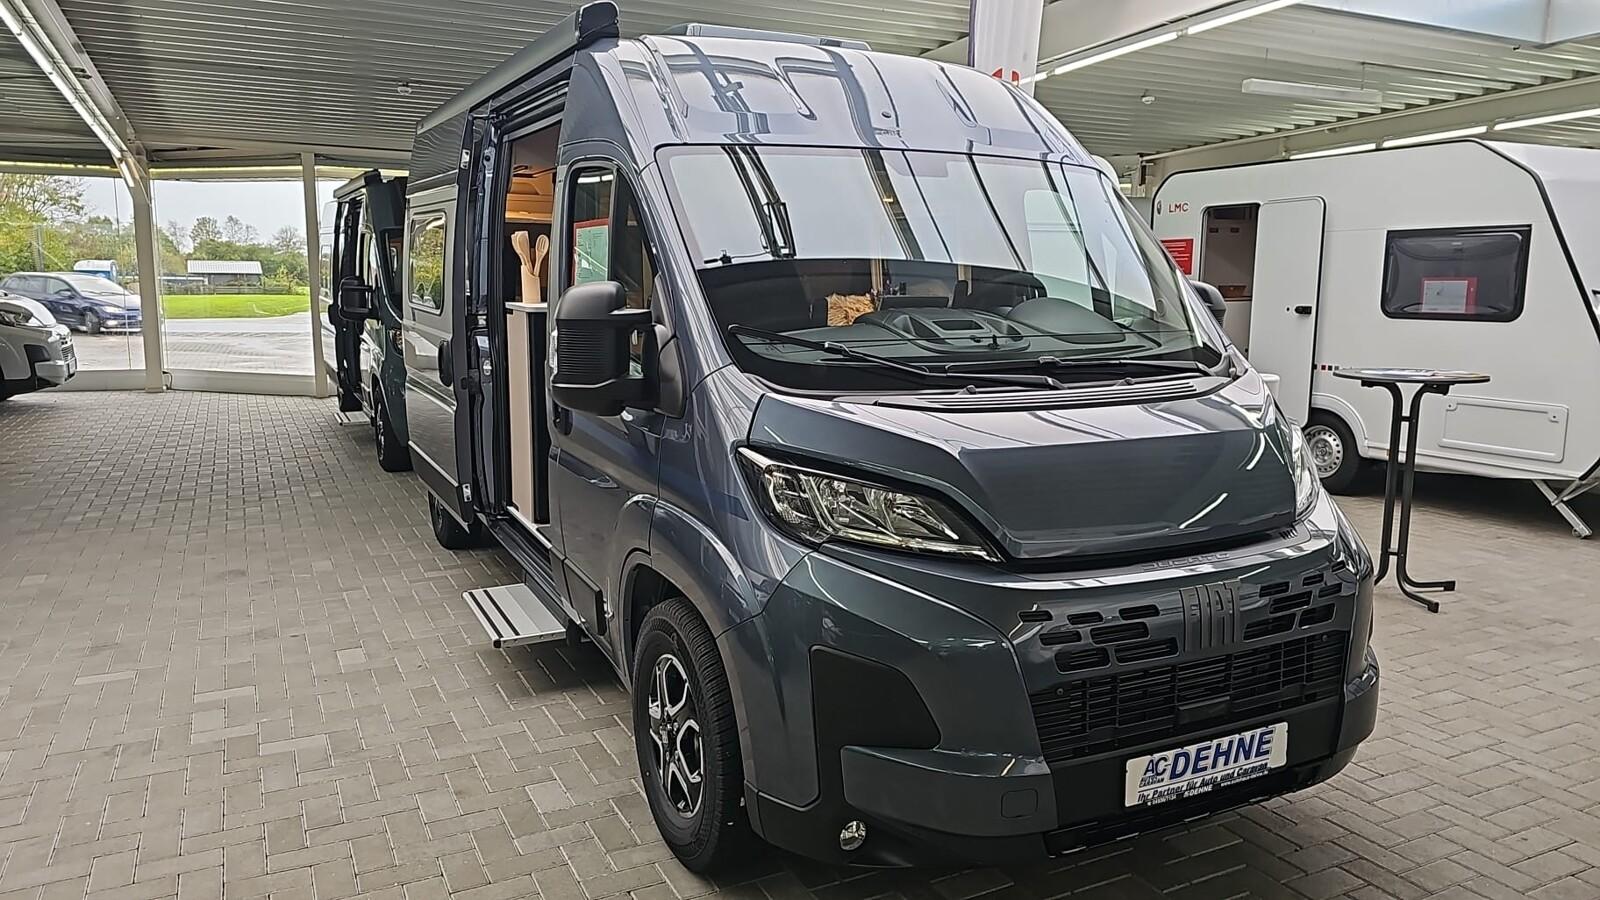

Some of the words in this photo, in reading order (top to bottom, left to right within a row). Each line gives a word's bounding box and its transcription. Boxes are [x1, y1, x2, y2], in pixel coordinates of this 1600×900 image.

[1168, 203, 1189, 213] LMC
[1179, 580, 1240, 653] FIAT
[1137, 793, 1151, 802] Ihr
[1152, 785, 1184, 798] Partner
[1186, 779, 1198, 791] für
[1200, 776, 1218, 787] Auto
[1220, 770, 1236, 780] und
